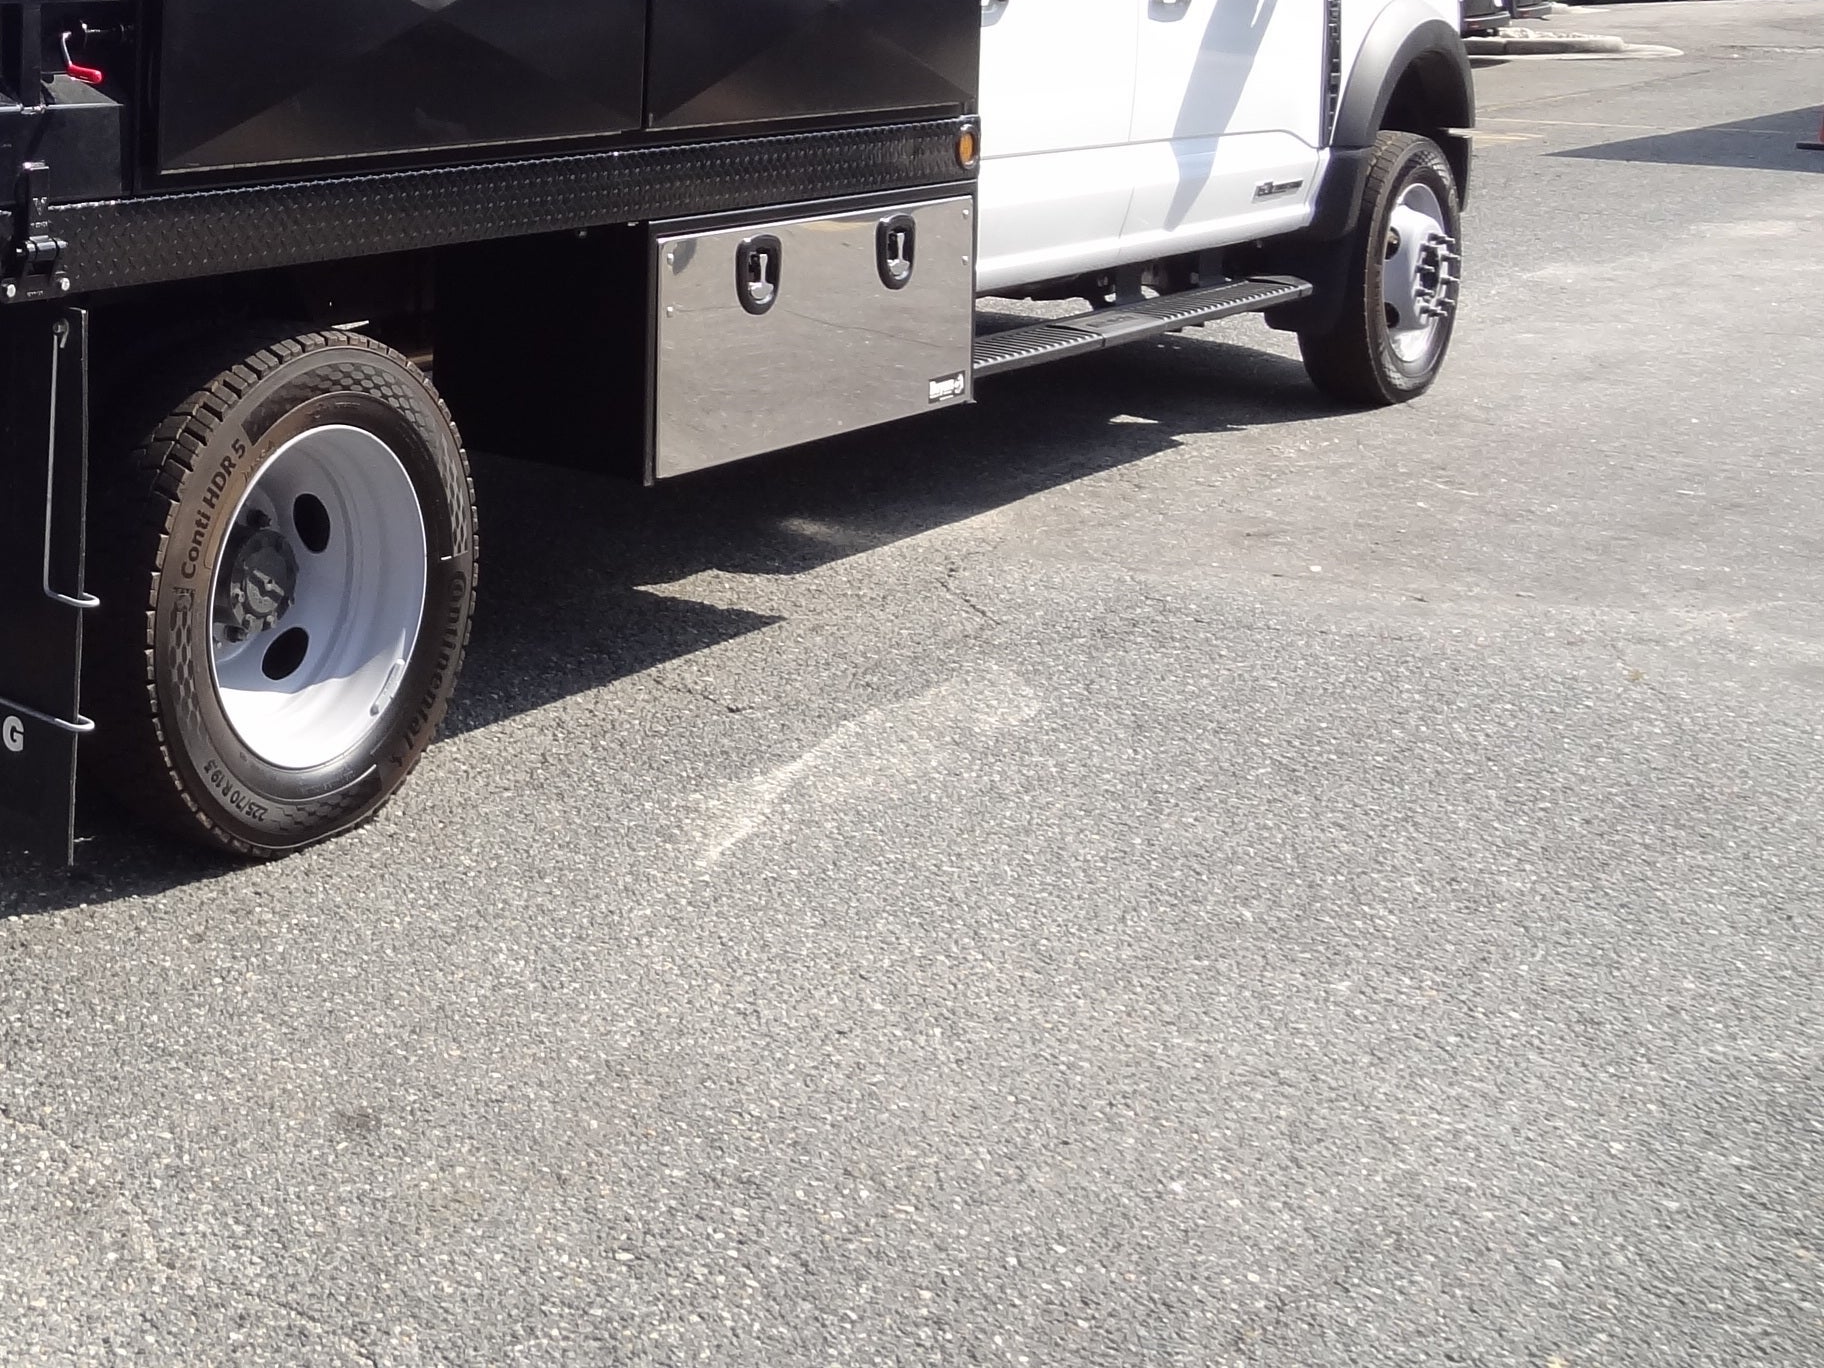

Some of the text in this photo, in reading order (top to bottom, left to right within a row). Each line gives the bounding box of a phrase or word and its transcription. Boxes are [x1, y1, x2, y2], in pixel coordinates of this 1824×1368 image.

[181, 438, 246, 579] Conti HDR 5
